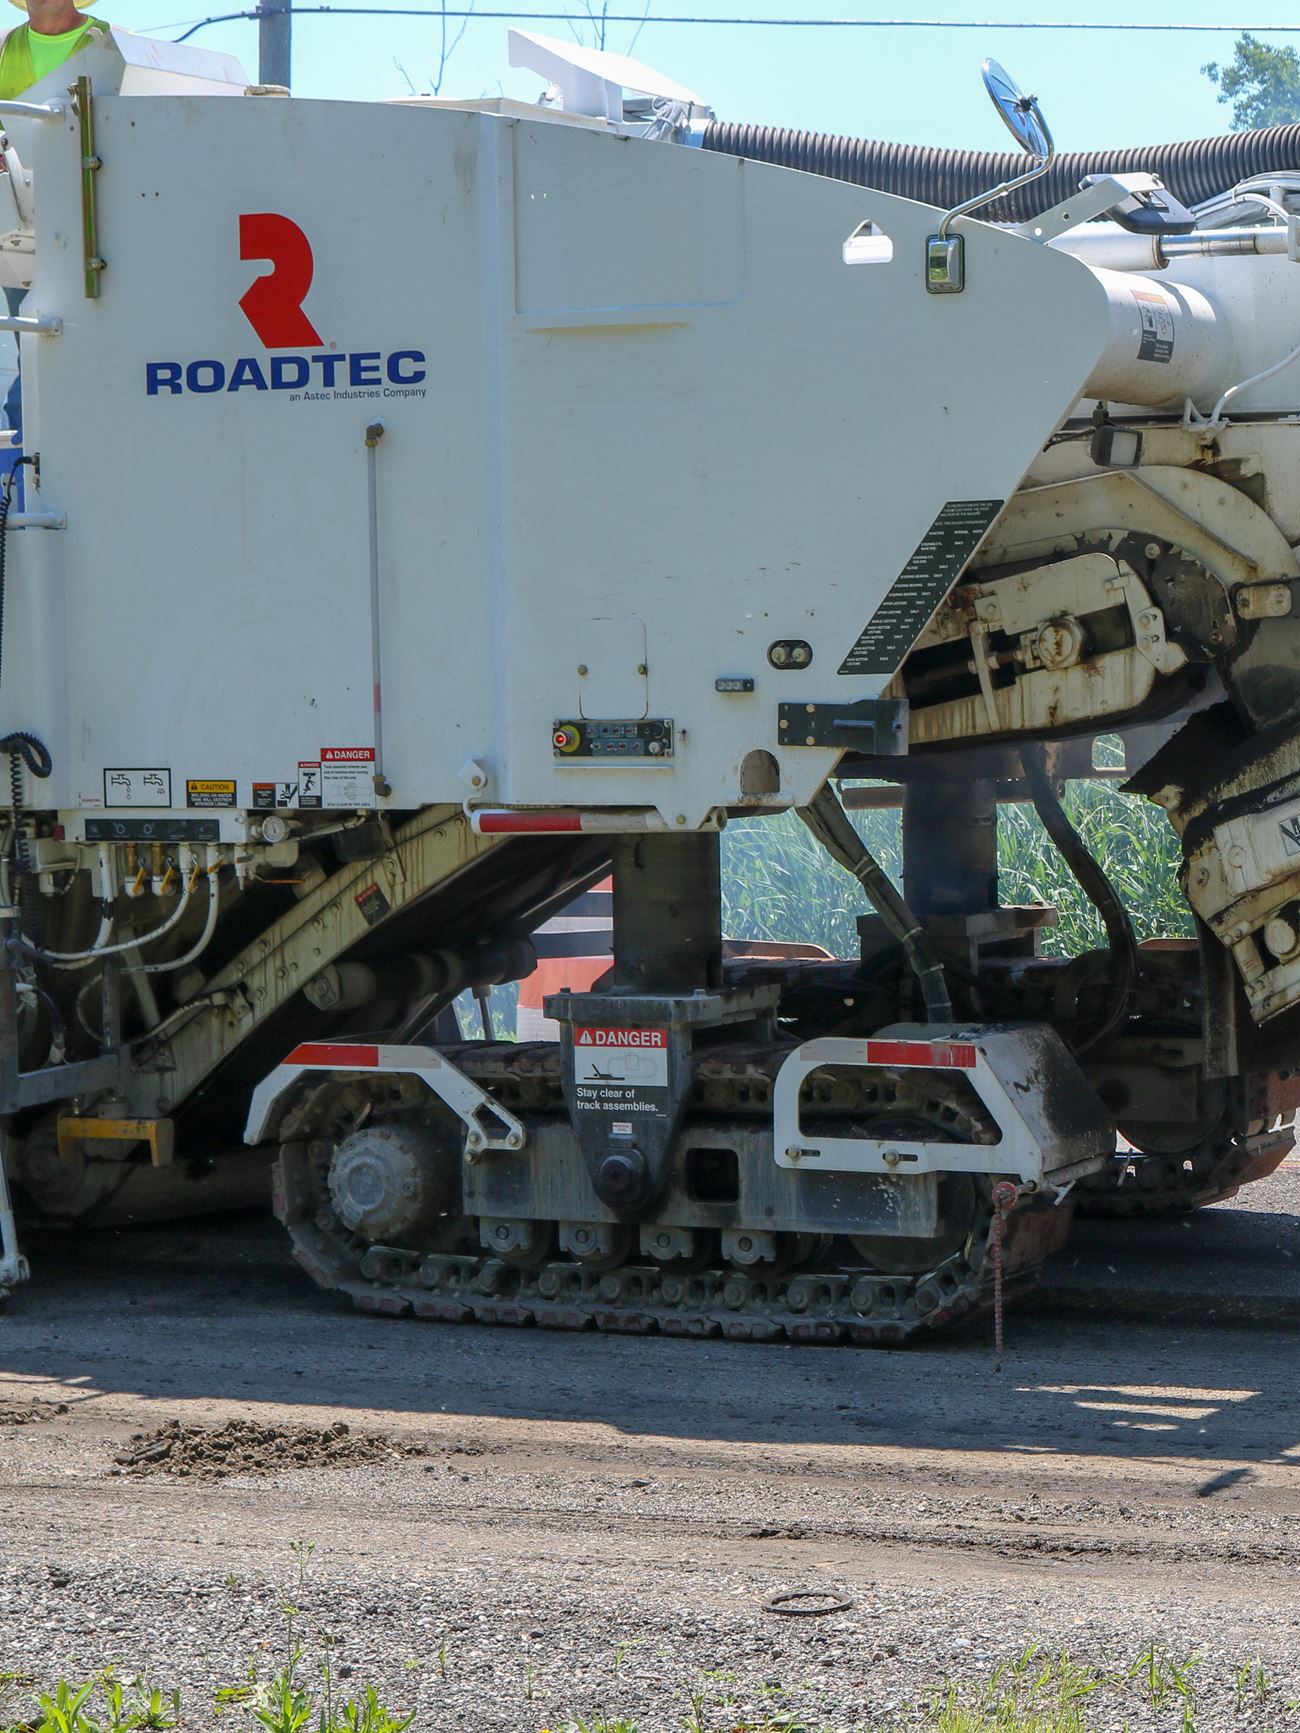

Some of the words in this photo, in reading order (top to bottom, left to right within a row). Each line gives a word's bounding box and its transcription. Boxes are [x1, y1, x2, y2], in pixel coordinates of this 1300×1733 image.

[146, 350, 426, 396] ROADTEC
[289, 393, 300, 402] an
[303, 391, 330, 401] Astec
[333, 388, 380, 400] Industries
[383, 387, 427, 399] Company
[334, 750, 370, 759] DANGER
[595, 1030, 662, 1046] DANGER
[577, 1087, 598, 1099] Stay
[600, 1088, 623, 1098] clear
[625, 1089, 636, 1098] of
[577, 1101, 601, 1110] track
[603, 1101, 659, 1112] assemblies.
